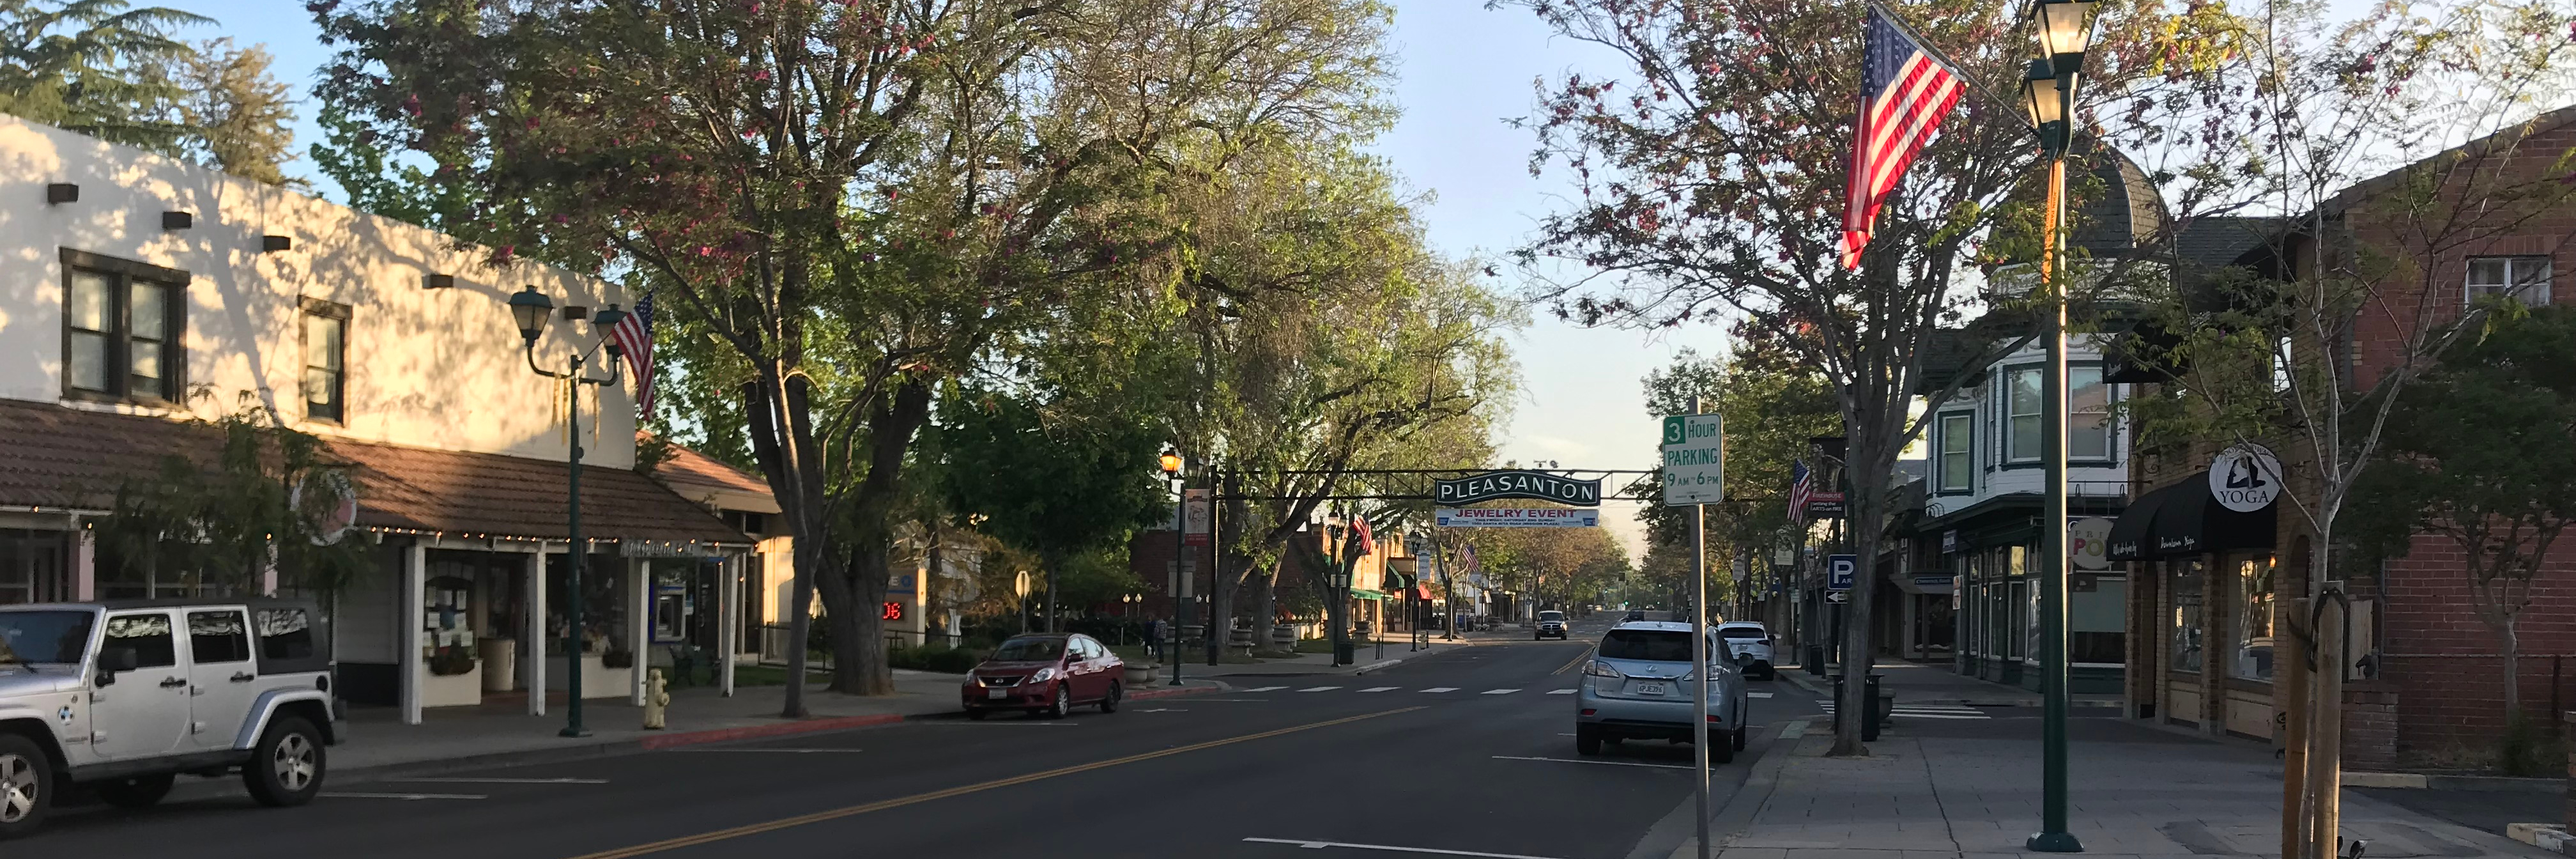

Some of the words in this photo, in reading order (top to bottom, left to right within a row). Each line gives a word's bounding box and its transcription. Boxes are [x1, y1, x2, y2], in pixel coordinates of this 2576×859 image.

[1668, 422, 1681, 442] 3
[1688, 423, 1716, 438] HOUR
[1667, 448, 1717, 466] PARKING
[1667, 473, 1675, 486] 9
[1678, 477, 1689, 486] AM
[1697, 472, 1705, 484] 6
[1707, 476, 1718, 484] PM
[1441, 476, 1593, 500] PLEASANTON
[2220, 490, 2269, 503] YOGA
[1455, 509, 1523, 518] JEWELRY
[1528, 509, 1577, 518] EVENT
